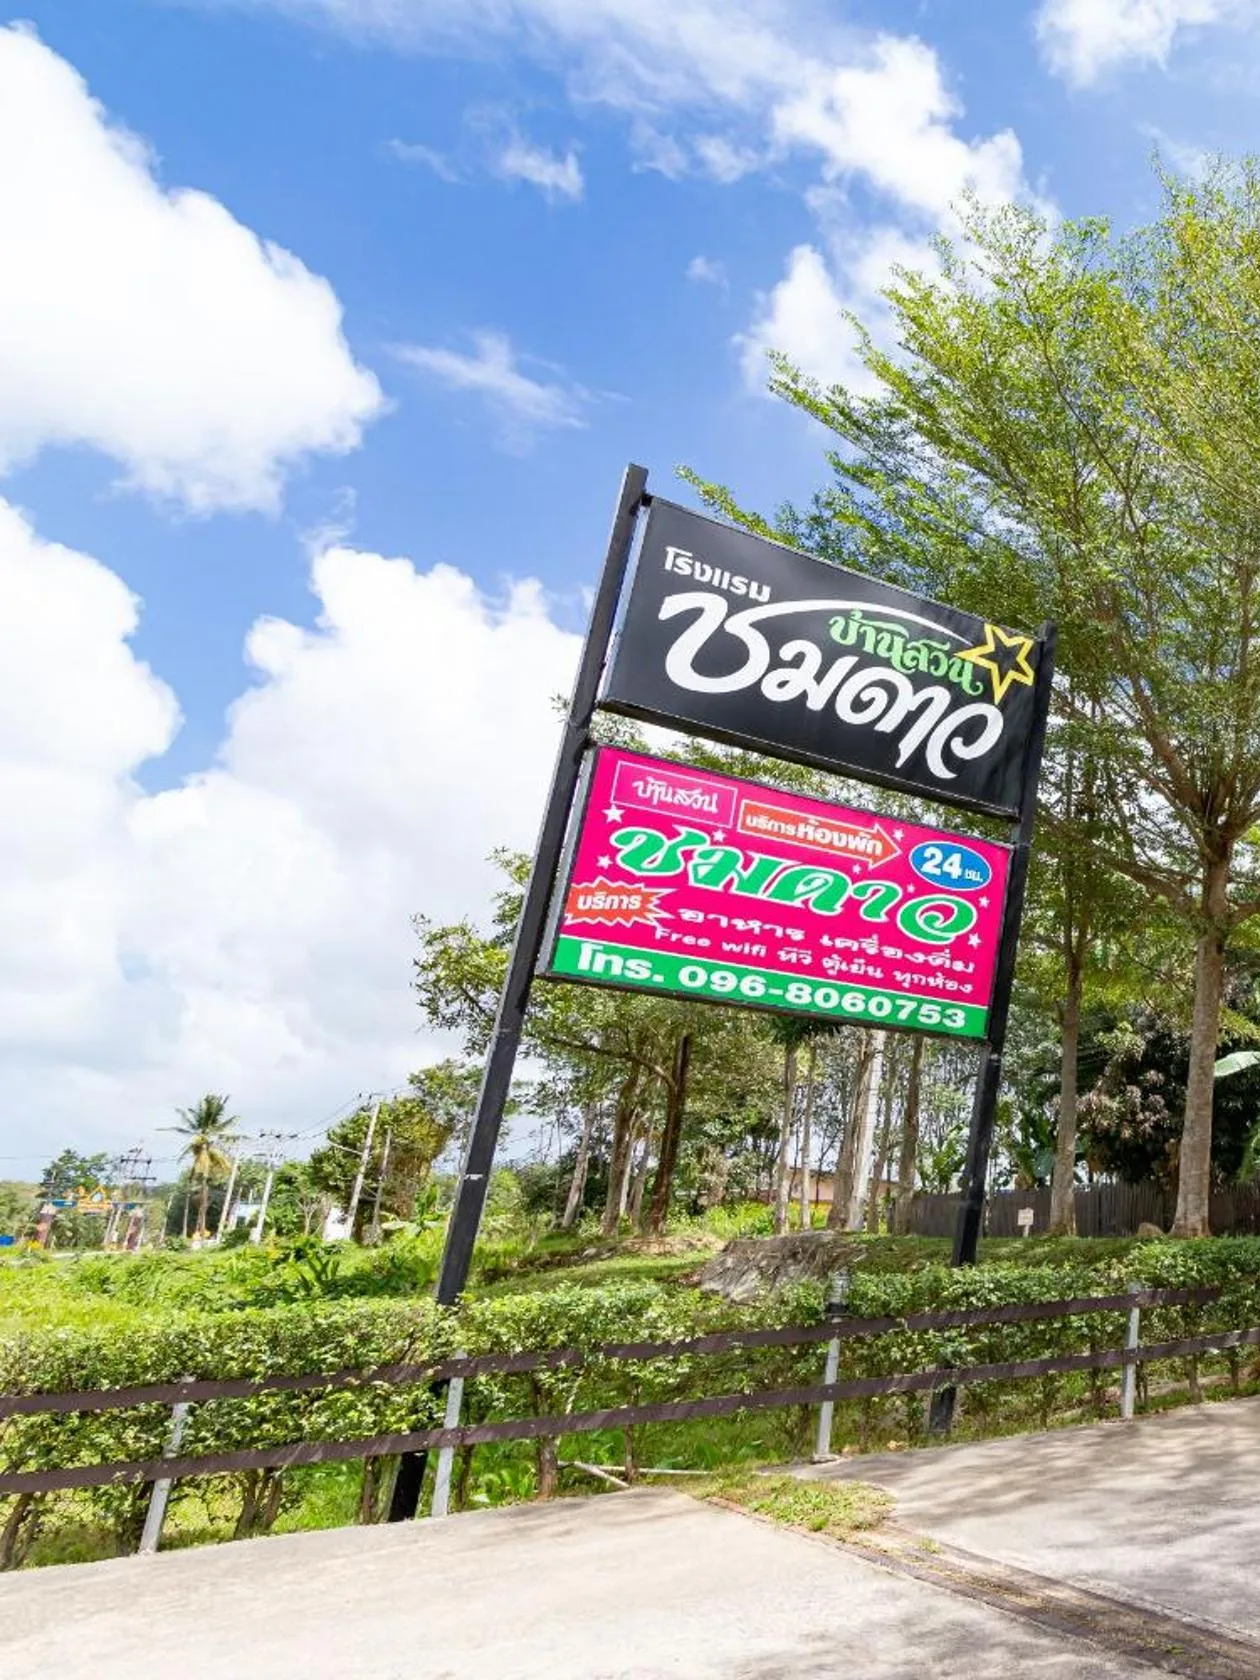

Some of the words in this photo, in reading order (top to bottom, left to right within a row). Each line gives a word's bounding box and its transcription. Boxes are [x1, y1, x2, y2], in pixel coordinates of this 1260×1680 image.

[664, 546, 771, 602] โรงแรม
[829, 608, 984, 695] บ้านสวน
[658, 591, 1004, 779] ชมดาว
[632, 776, 719, 813] บ้านสวน
[609, 824, 978, 945] ชมดาว
[920, 846, 961, 879] 24
[577, 891, 643, 911] บริการ
[655, 926, 711, 948] Free
[722, 940, 768, 958] wifi
[678, 908, 806, 941] อาหาร
[577, 943, 665, 983] โทร.
[678, 964, 967, 1029] 096-8060753
